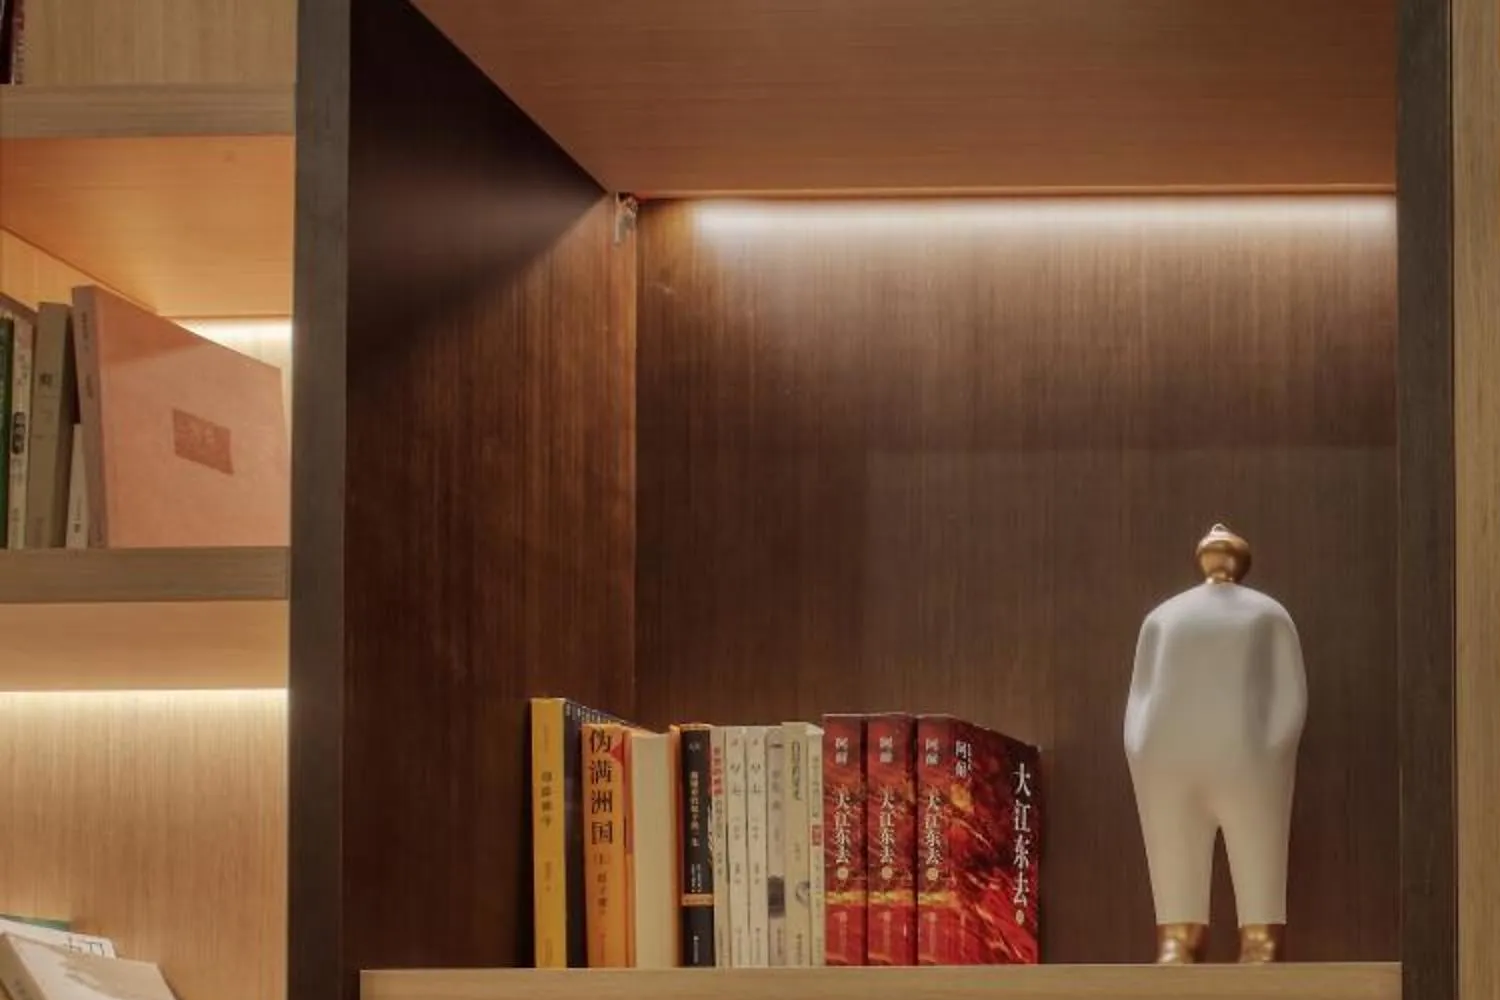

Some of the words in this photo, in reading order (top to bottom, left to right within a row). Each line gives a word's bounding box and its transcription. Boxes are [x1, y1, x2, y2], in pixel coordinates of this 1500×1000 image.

[589, 728, 613, 845] 伪满洲国
[834, 787, 851, 864] 大江东去
[879, 787, 895, 864] 大江东去
[925, 787, 941, 865] 大江东去
[1012, 762, 1031, 908] 大江东去
